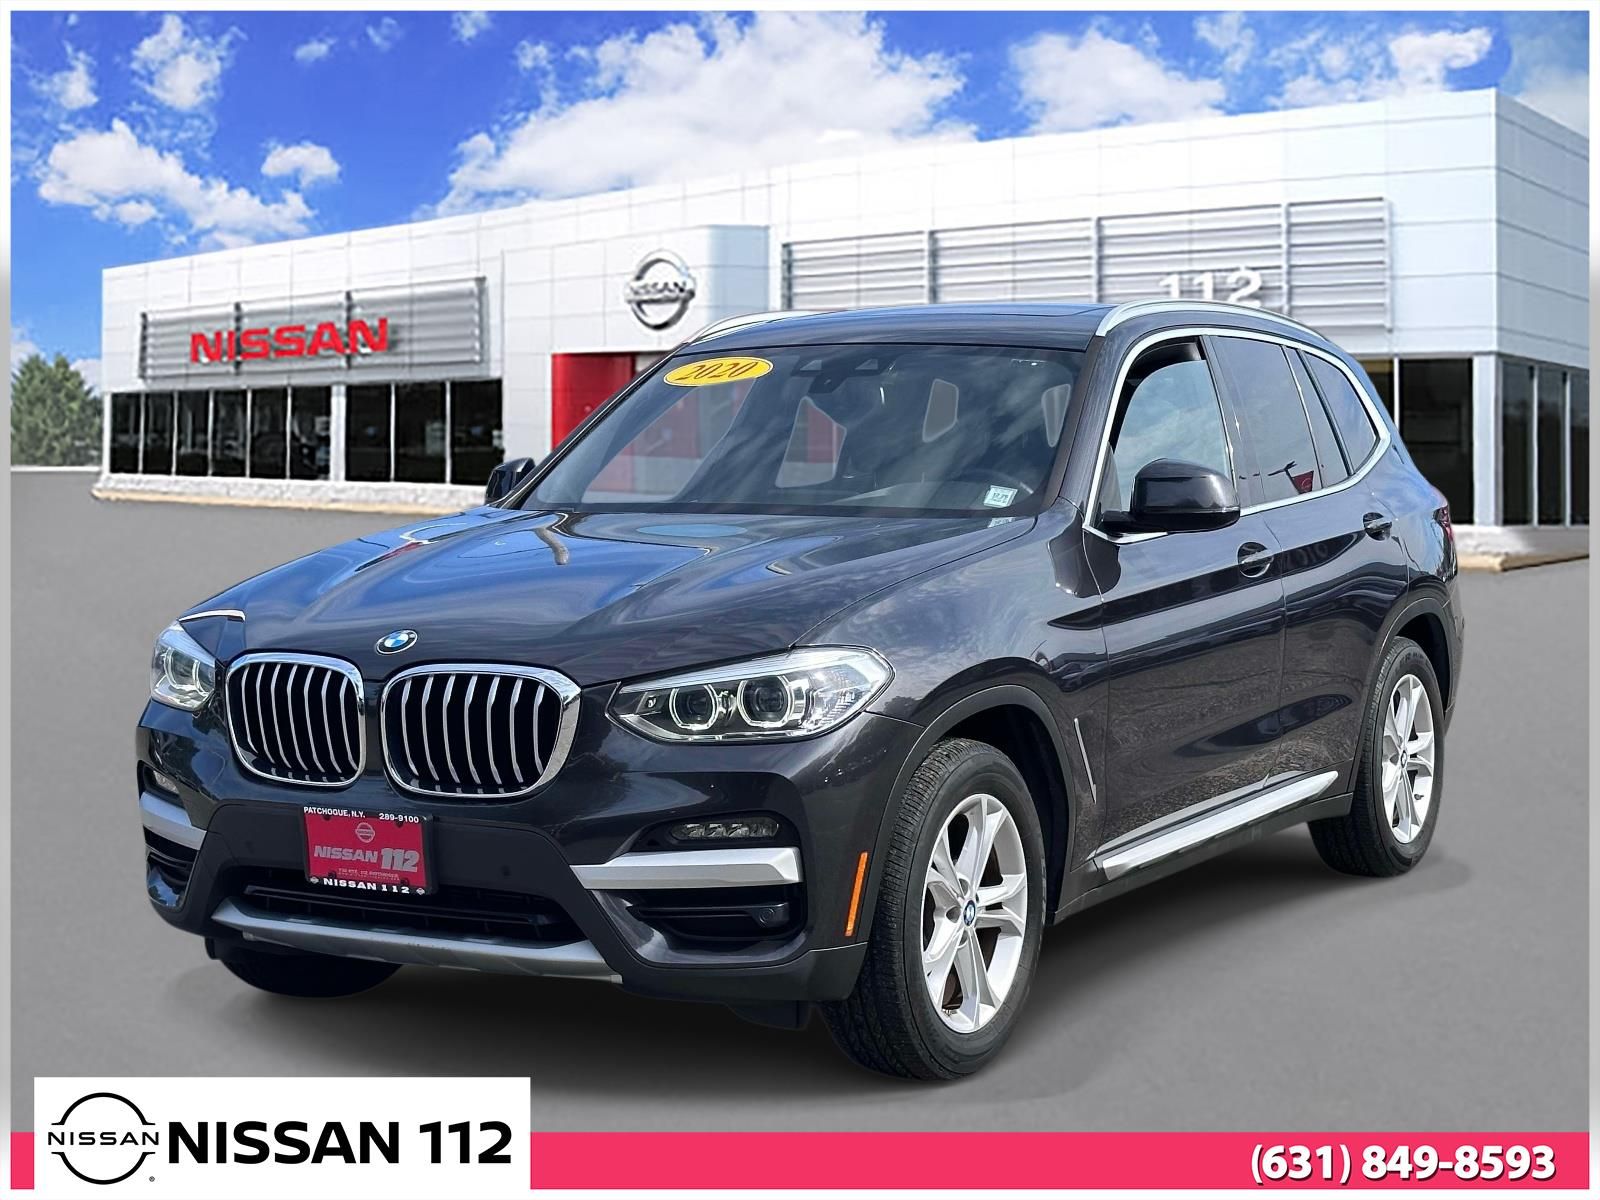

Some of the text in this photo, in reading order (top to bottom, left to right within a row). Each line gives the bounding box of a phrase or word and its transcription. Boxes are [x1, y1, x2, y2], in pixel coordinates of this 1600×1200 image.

[1159, 270, 1262, 308] 112
[190, 317, 388, 363] NISSAN
[675, 361, 758, 380] 2020
[379, 812, 419, 823] 289-9100
[313, 845, 420, 872] NISSAN 112
[323, 877, 377, 891] NISSAN
